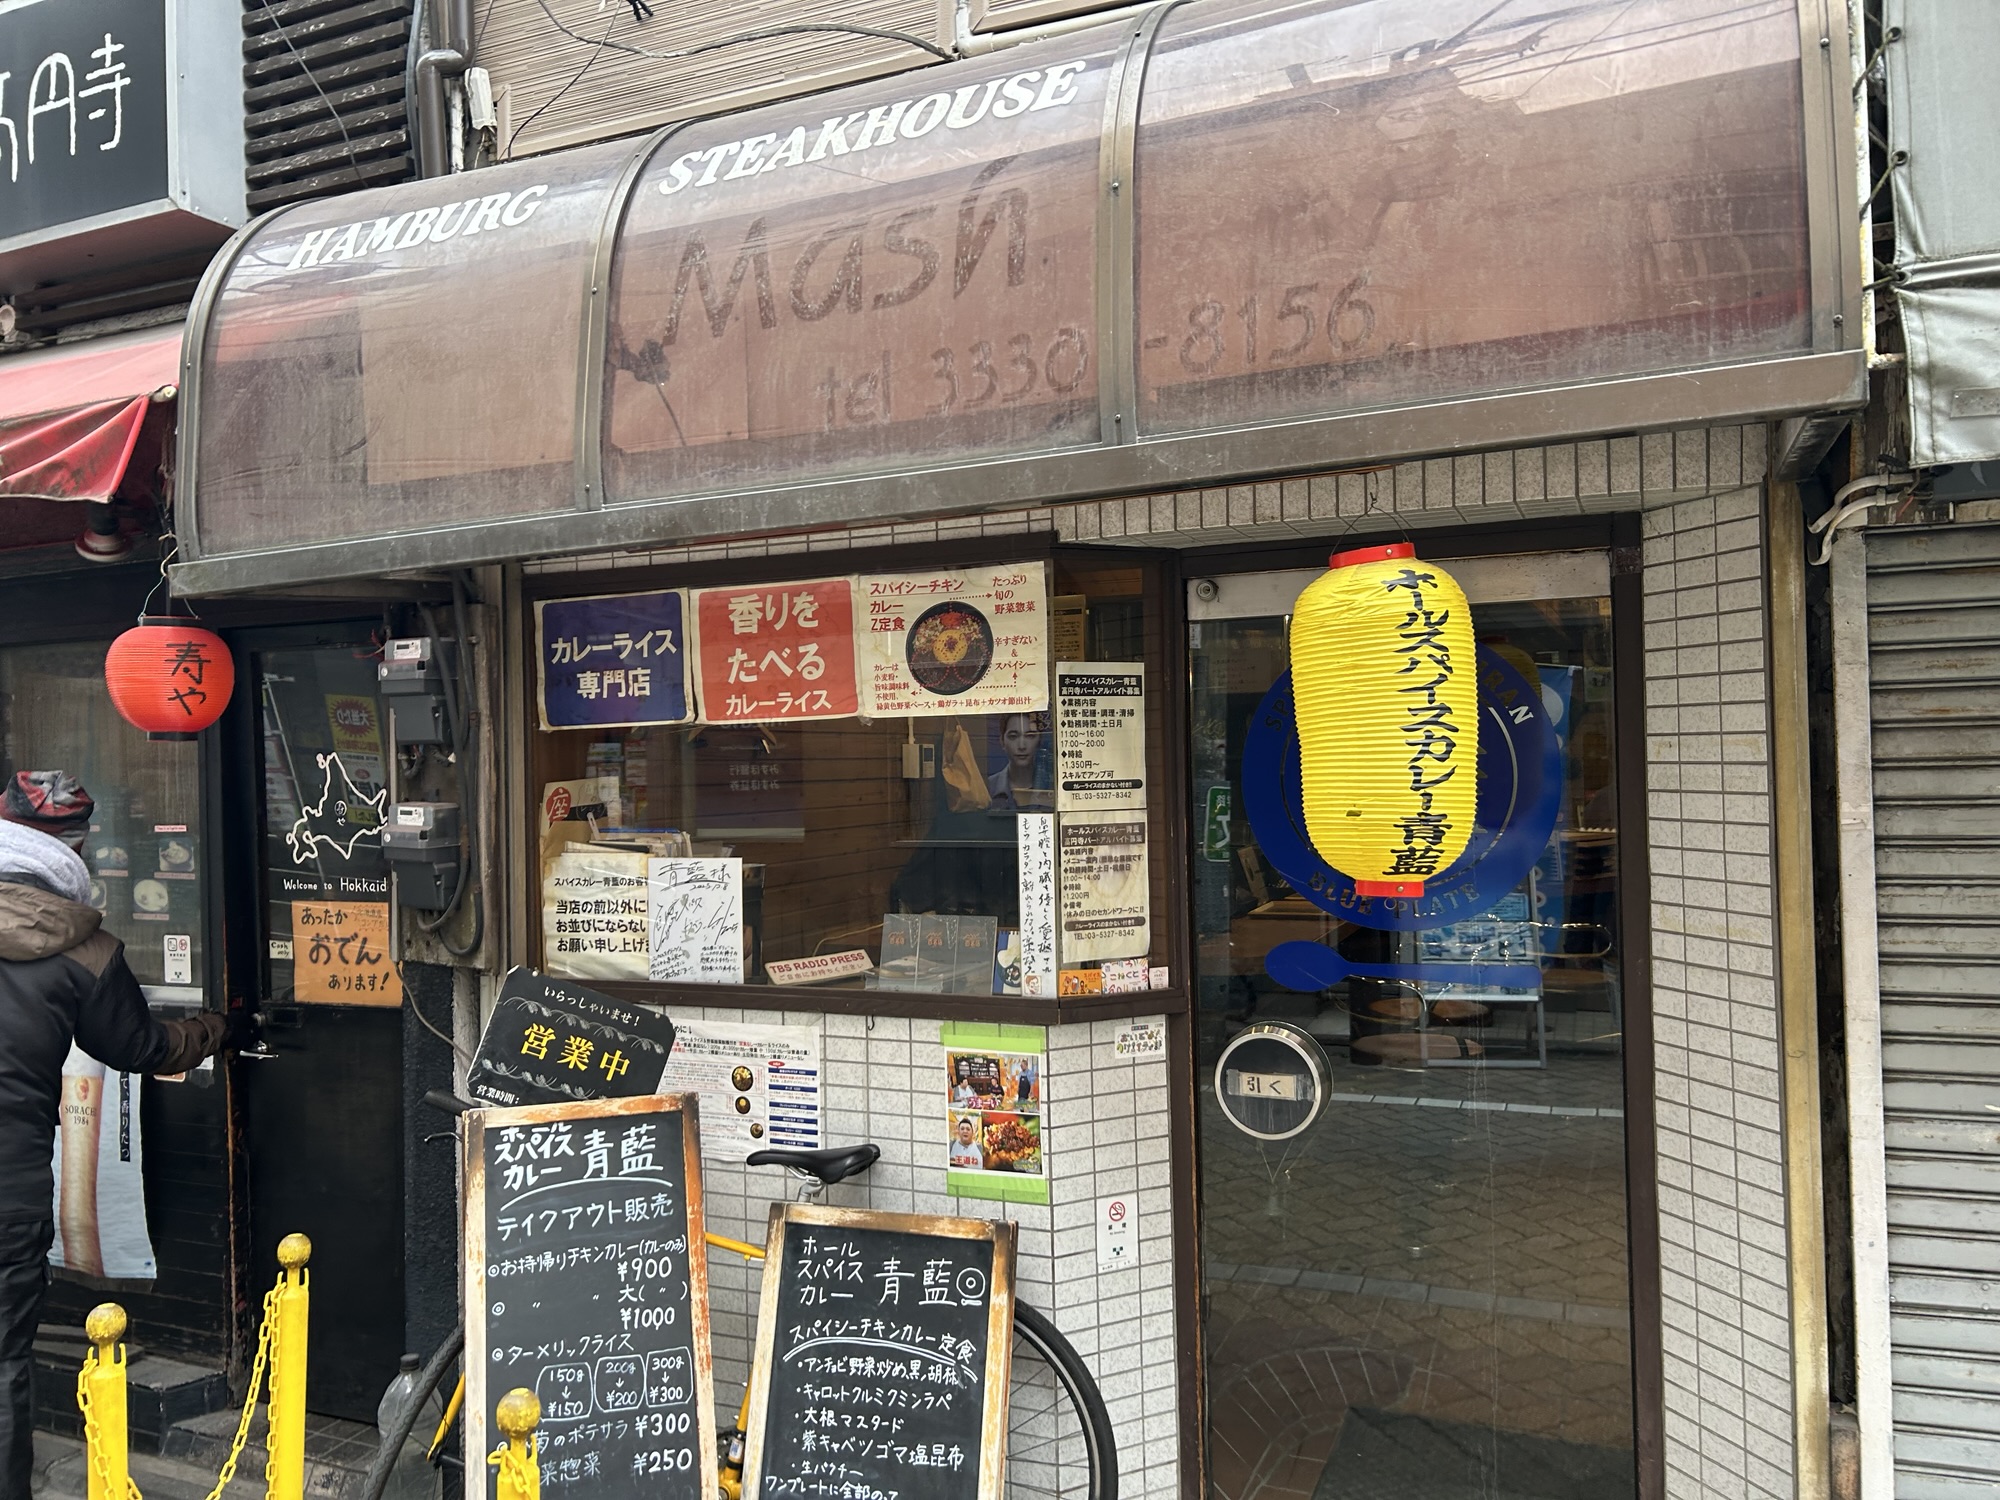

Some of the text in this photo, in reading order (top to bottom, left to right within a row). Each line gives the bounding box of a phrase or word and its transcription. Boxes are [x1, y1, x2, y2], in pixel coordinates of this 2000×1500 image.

[0, 32, 131, 183] 円寺
[659, 59, 1086, 196] STEAKHOUSE
[285, 184, 549, 272] HAMBURG
[816, 349, 891, 429] tel
[870, 579, 964, 596] スパイシーチキン
[992, 574, 1027, 587] たっぷり
[870, 600, 904, 613] カレー
[994, 590, 1014, 601] 旬の
[994, 602, 1036, 615] 野菜惣菜
[728, 591, 819, 635] 香りを
[551, 629, 677, 665] カレーライス
[994, 636, 1038, 647] 辛すぎない
[1011, 649, 1018, 657] &
[165, 640, 211, 715] 寿や
[727, 642, 825, 685] たべる
[873, 664, 899, 672] カレーは
[995, 662, 1036, 671] スパイシー
[577, 667, 651, 700] 専門店
[874, 683, 910, 692] 旨味調味料
[725, 689, 832, 717] カレーライス
[1381, 569, 1459, 876] ホールスパイスカレー青藍
[548, 787, 570, 822] 座
[283, 879, 318, 891] Welcome
[1307, 870, 1481, 919] BLUE PLATE
[301, 907, 348, 926] あったか
[555, 899, 649, 915] 当店の前以外に
[271, 942, 289, 950] Cash
[309, 932, 382, 967] おでん
[769, 952, 865, 974] TBS RADIO PRESS
[779, 963, 864, 981] ご自由にお持ちください
[328, 972, 389, 991] あります!
[544, 986, 641, 1027] いらっしゃいませ!
[520, 1022, 631, 1082] 営業中
[1246, 1075, 1282, 1095] 引く
[120, 1073, 130, 1158] て、香りたつ
[494, 1134, 575, 1165] スパイス
[503, 1165, 562, 1191] カレー
[580, 1123, 664, 1179] 青藍
[497, 1192, 674, 1242] テイクアウト販売
[803, 1236, 860, 1257] ホール
[617, 1256, 673, 1283] ¥900
[797, 1259, 864, 1283] スパイス
[800, 1256, 957, 1307] カレー 青藍
[620, 1307, 675, 1331] ¥1000
[508, 1333, 635, 1366] ターメリックライス
[789, 1318, 977, 1361] スパイシーチキンカレー定食
[547, 1387, 683, 1418] ¥150 ¥200 ¥300
[526, 1413, 691, 1454] 菊のポテサラ ¥300
[633, 1448, 693, 1476] ¥250
